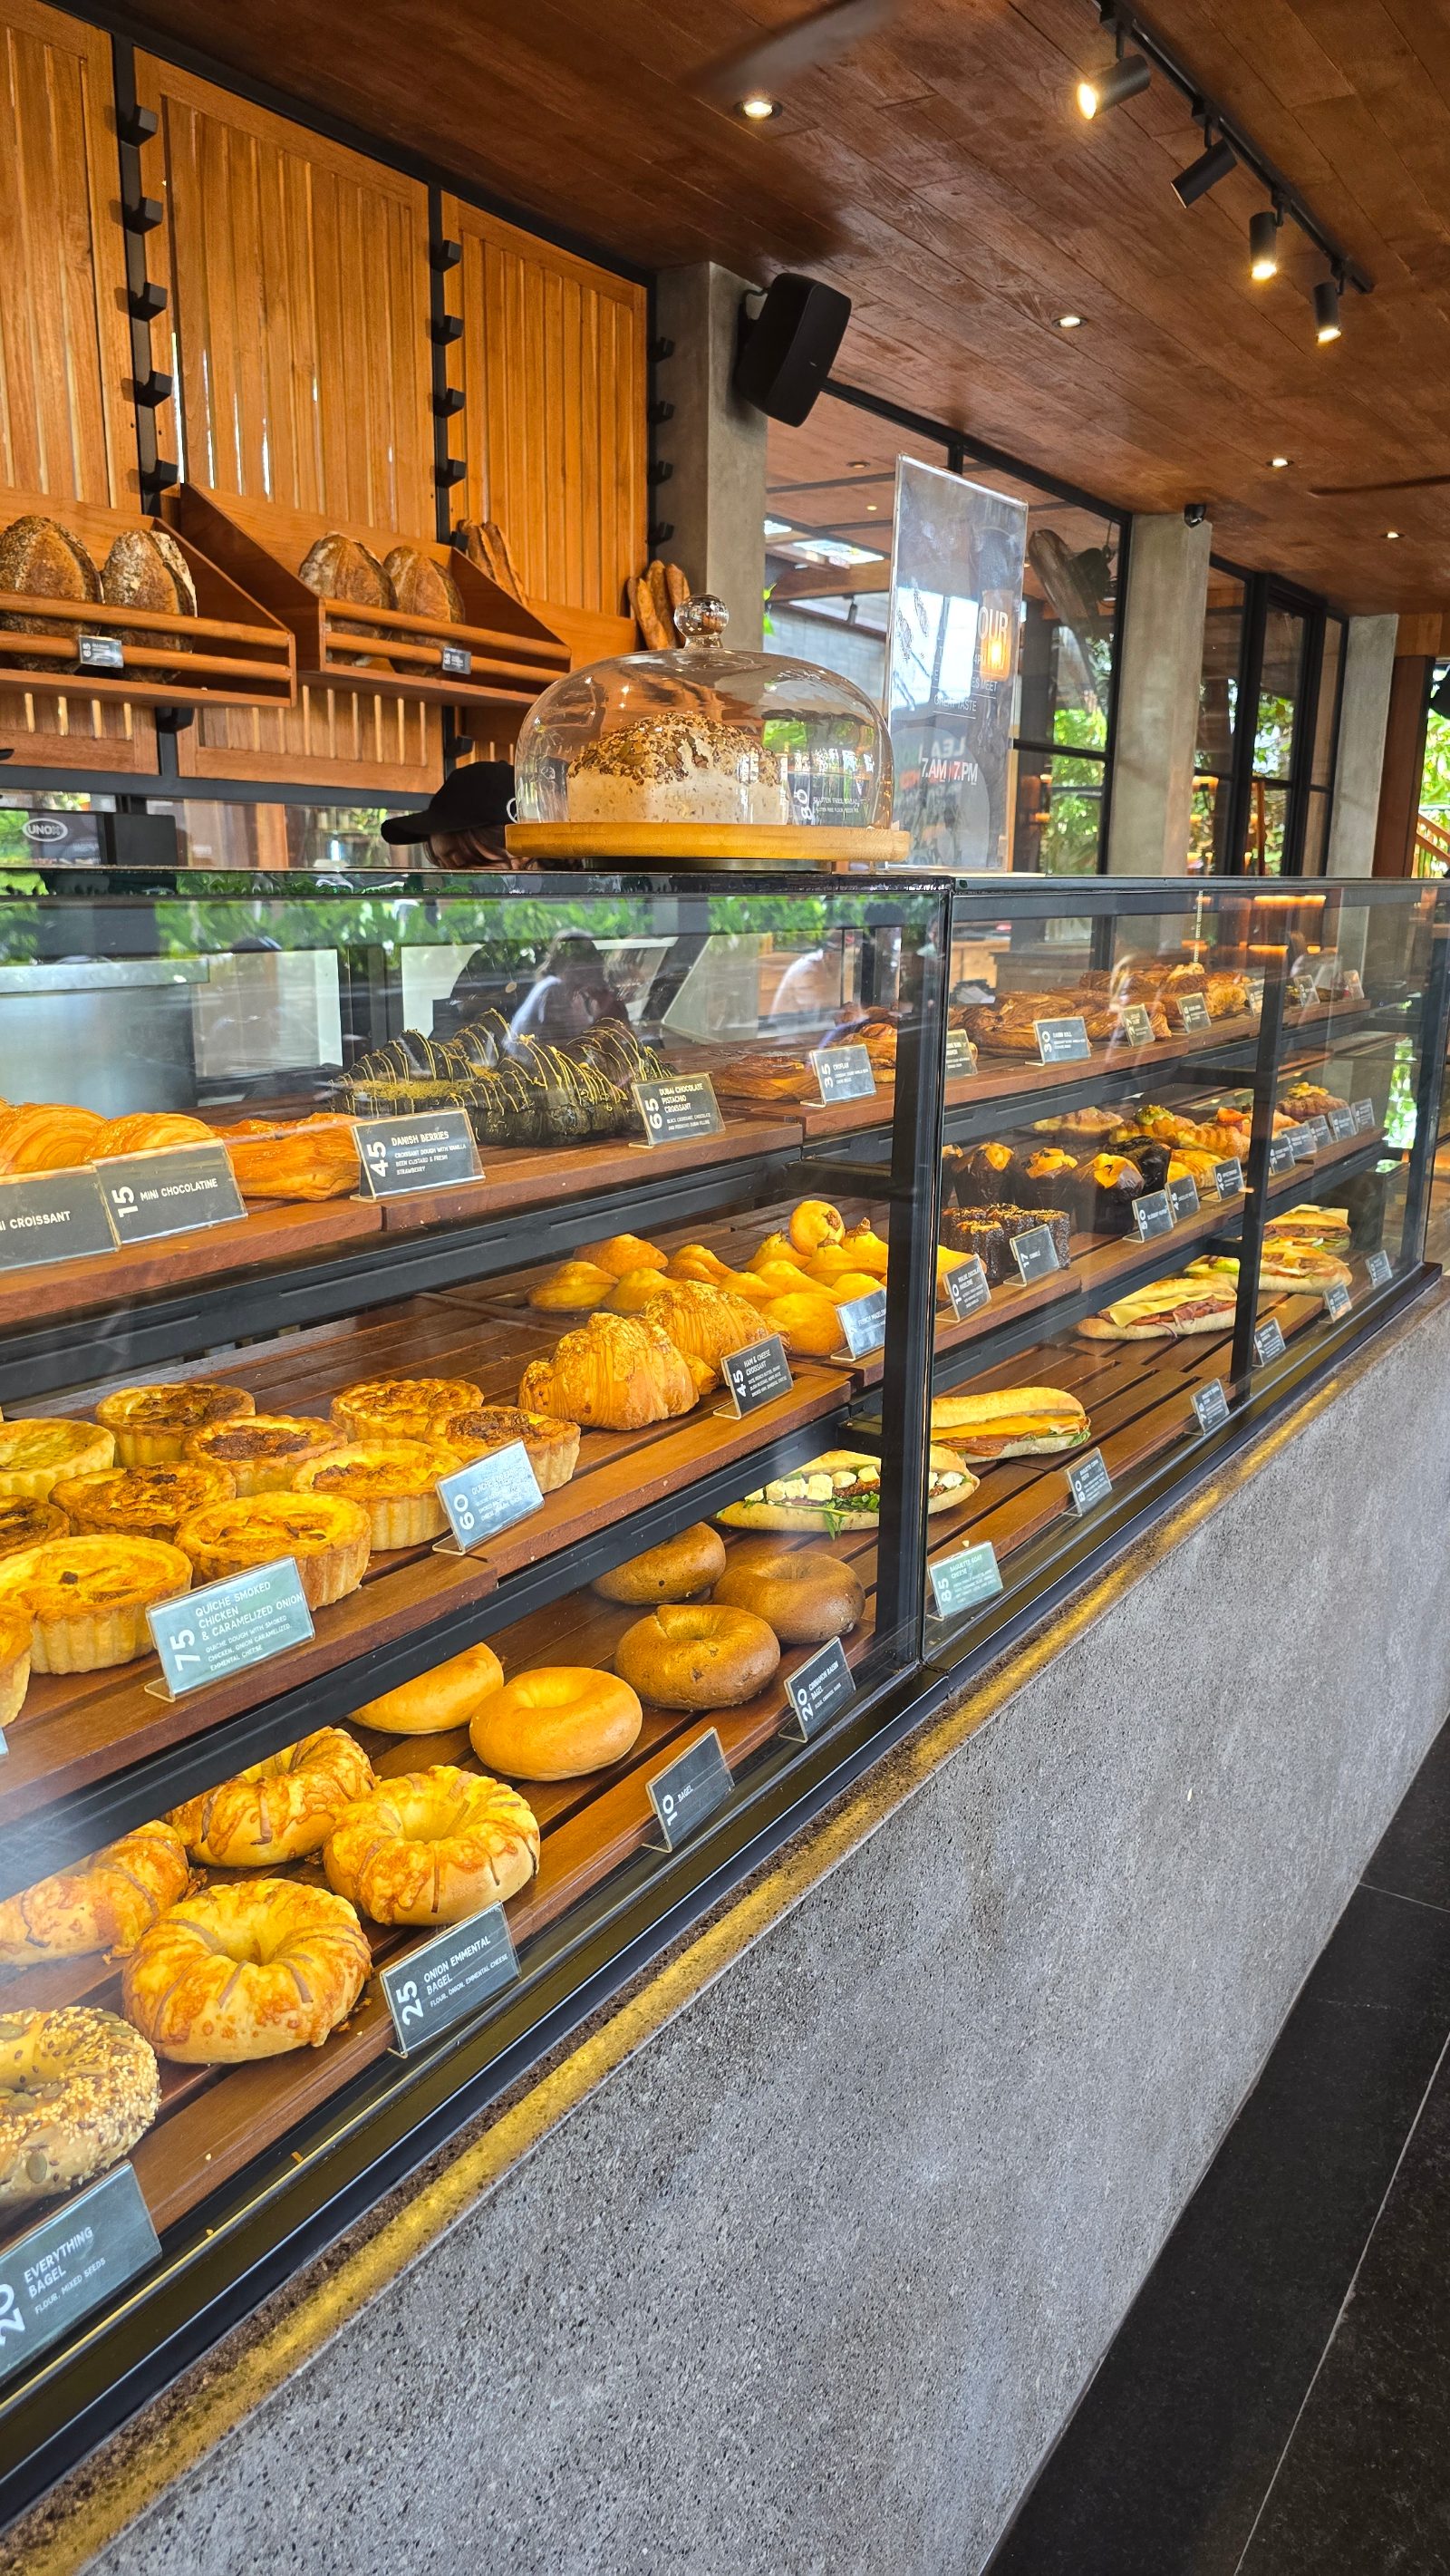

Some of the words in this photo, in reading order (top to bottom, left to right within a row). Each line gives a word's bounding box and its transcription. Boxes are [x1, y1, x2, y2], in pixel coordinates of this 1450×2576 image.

[981, 679, 998, 692] MEET
[958, 699, 977, 712] TASTE
[27, 825, 61, 836] UNOX
[821, 1063, 834, 1088] 35
[659, 1087, 675, 1096] DUBAI
[674, 1083, 703, 1094] CHOCOLATE
[662, 1095, 687, 1105] PISTACHIO
[644, 1098, 662, 1129] 65
[664, 1103, 691, 1113] CROISSANT
[392, 1134, 420, 1147] DANISH
[420, 1130, 450, 1143] BERRIES
[367, 1141, 389, 1177] 45
[394, 1149, 420, 1158] CROISSANT
[420, 1148, 436, 1156] DOUGH
[408, 1157, 429, 1166] CUSTARD
[396, 1166, 425, 1176] STRAWBERRY
[112, 1186, 139, 1218] 15
[140, 1191, 159, 1202] MINI
[160, 1178, 218, 1198] CHOCOLATINE
[9, 1210, 72, 1229] CROISSANT
[952, 1284, 962, 1305] 10
[743, 1357, 754, 1368] HAM
[753, 1355, 758, 1363] &
[757, 1349, 771, 1361] CHEESE
[746, 1361, 767, 1376] CROISSANT
[732, 1370, 747, 1398] 45
[1075, 1479, 1086, 1503] 80
[454, 1494, 475, 1530] 60
[949, 1559, 972, 1573] BAGUETTE
[951, 1567, 968, 1579] CHEESE
[195, 1594, 231, 1618] QUICHE
[234, 1581, 271, 1603] SMOKED
[937, 1577, 952, 1603] 85
[198, 1605, 239, 1629] CHICKEN
[201, 1631, 210, 1641] &
[212, 1605, 273, 1637] CARAMELIZED
[276, 1593, 305, 1611] ONION
[206, 1640, 227, 1653] QUICHE
[227, 1631, 249, 1644] DOUGH
[249, 1624, 265, 1635] WITH
[265, 1614, 287, 1629] SMOKED
[235, 1638, 254, 1651] ONION
[169, 1629, 201, 1671] 75
[210, 1654, 241, 1671] EMMENTAL
[241, 1644, 263, 1658] CHEESE
[808, 1670, 828, 1691] CINNAMON
[826, 1661, 839, 1676] RAISIN
[798, 1688, 814, 1722] 20
[811, 1686, 825, 1700] BAGEL
[677, 1784, 694, 1803] BAGEL
[662, 1794, 678, 1826] 10
[423, 1960, 450, 1983] ONION
[450, 1935, 491, 1968] EMMENTAL
[465, 1965, 490, 1985] EMMENTAL
[490, 1953, 509, 1969] CHEESE
[426, 1973, 453, 1996] BAGEL
[395, 1980, 424, 2026] 25
[24, 2226, 94, 2284] EVERYTHING
[28, 2265, 67, 2299] BAGEL
[35, 2292, 61, 2315] FLOUR,
[61, 2274, 83, 2296] MIXED
[83, 2257, 106, 2278] SEEDS
